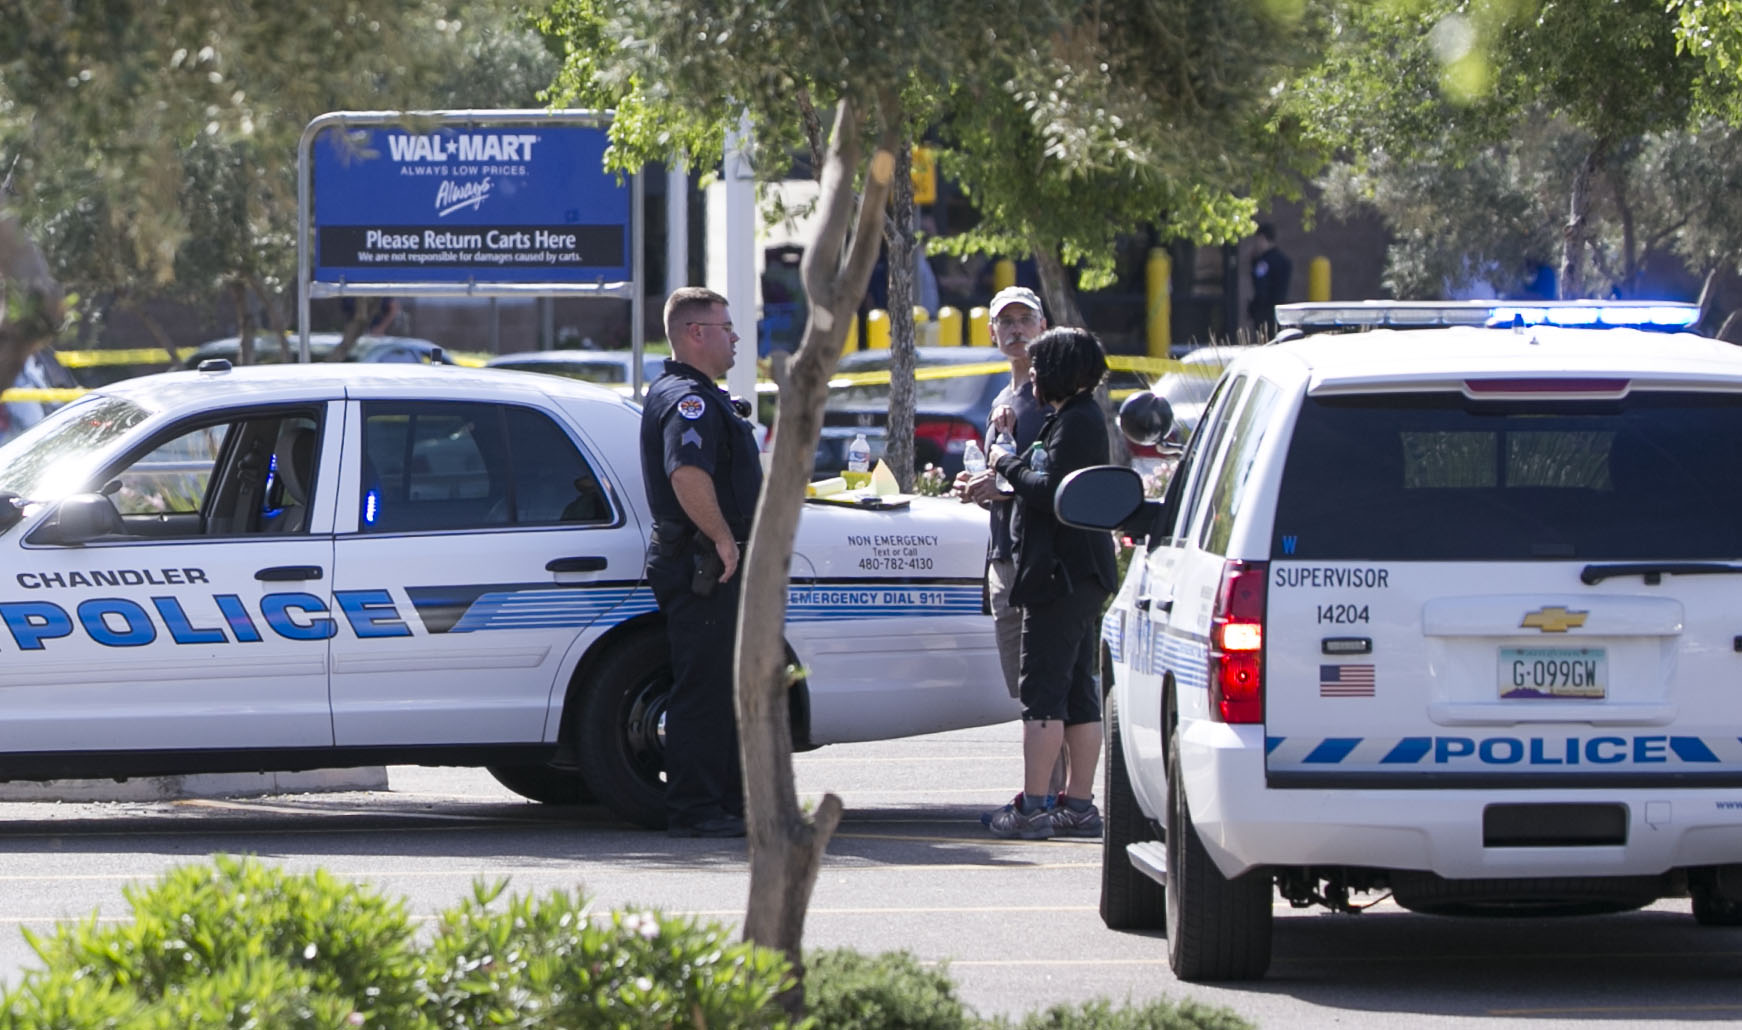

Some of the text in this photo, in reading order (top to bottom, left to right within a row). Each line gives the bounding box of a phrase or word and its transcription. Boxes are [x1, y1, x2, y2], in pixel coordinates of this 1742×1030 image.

[400, 165, 530, 176] ALWAYS LOW PRICES.
[434, 176, 495, 217] Always
[365, 229, 577, 249] Please Return Carts Here
[358, 251, 583, 265] We are not responsible for damages caused by carts.
[848, 536, 938, 546] NON EMERGENCY
[1282, 535, 1298, 555] W
[873, 548, 890, 557] Text
[903, 548, 918, 557] Call
[858, 559, 934, 571] 480-782-4130
[16, 568, 209, 589] CHANDLER
[1275, 567, 1389, 588] SUPERVISOR
[790, 591, 944, 604] EMERGENCY DIAL 911
[0, 589, 414, 651] POLICE
[1316, 605, 1370, 624] 14204
[1434, 736, 1668, 765] POLICE
